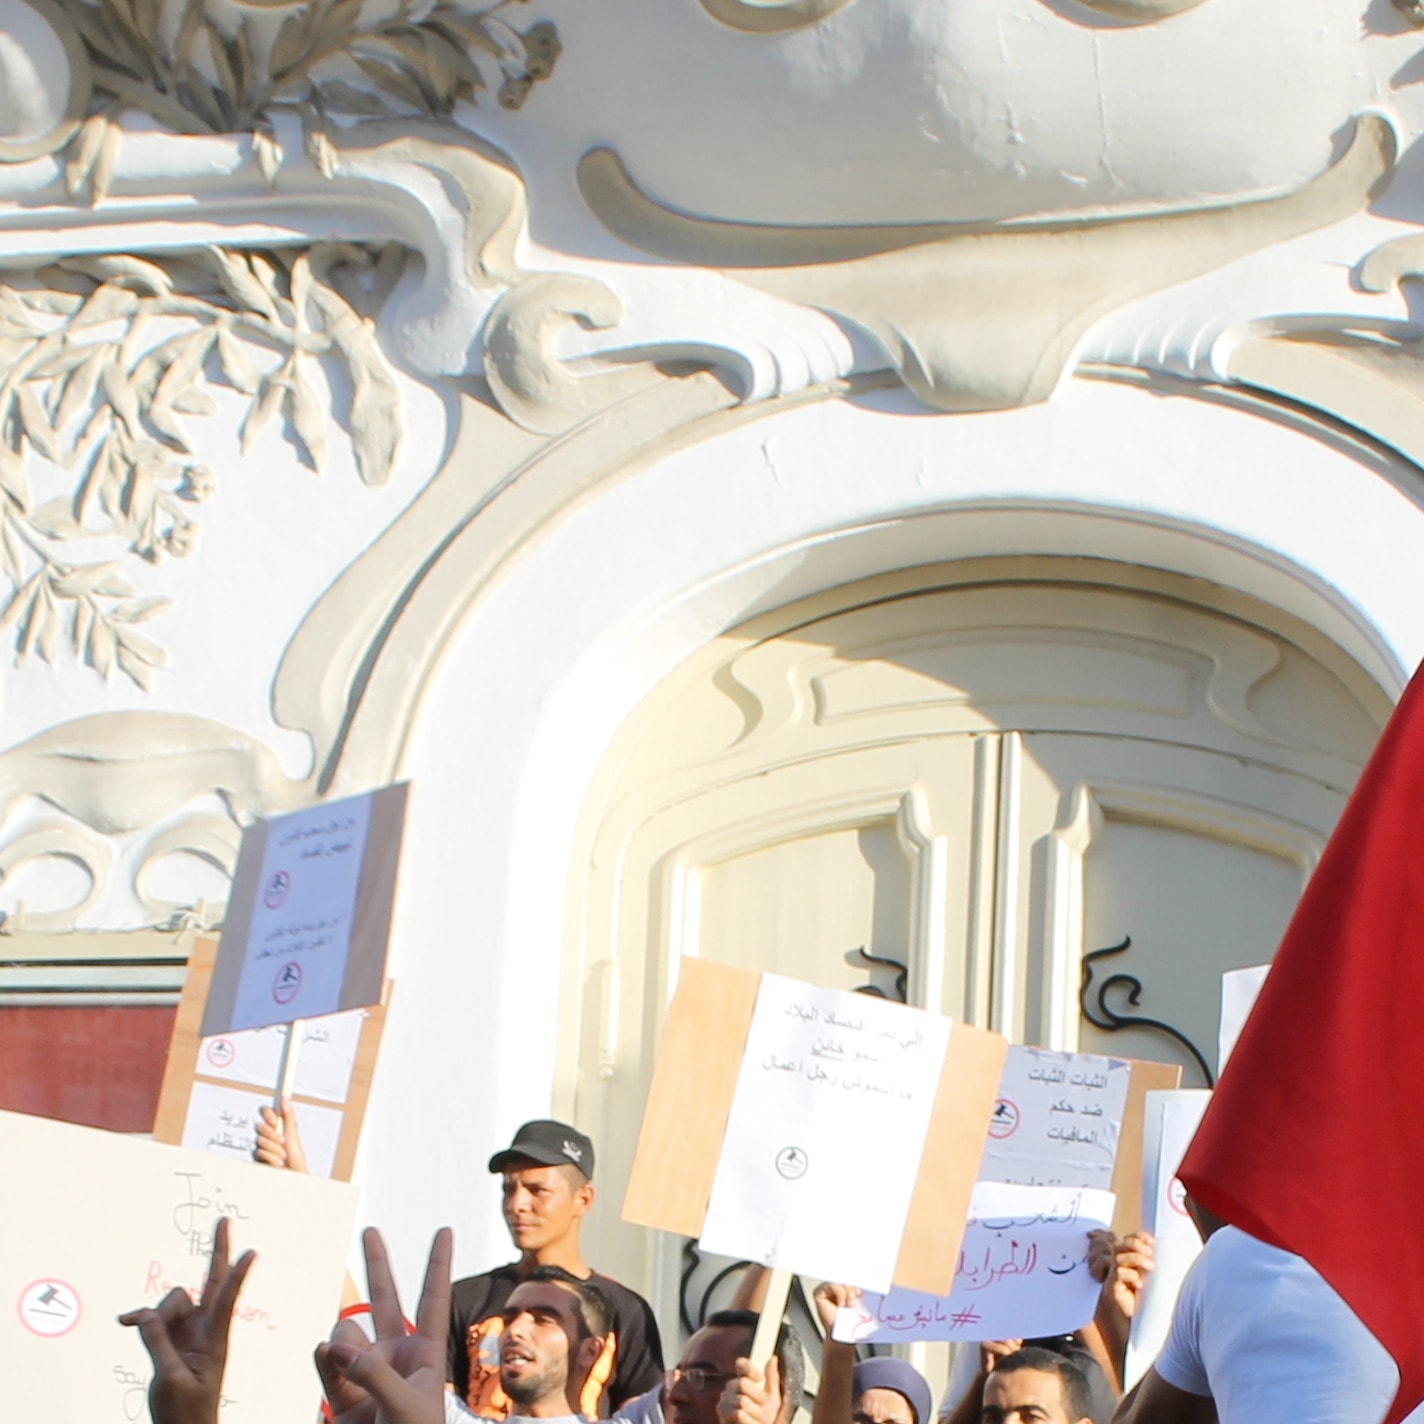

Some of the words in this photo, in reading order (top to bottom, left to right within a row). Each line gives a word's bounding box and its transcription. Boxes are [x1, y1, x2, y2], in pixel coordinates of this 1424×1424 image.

[1028, 1067, 1066, 1086] الثبات
[1070, 1072, 1108, 1091] الثبات
[1049, 1099, 1076, 1118] حكم
[1080, 1102, 1104, 1118] ضد
[1047, 1125, 1099, 1145] المافيات
[172, 1171, 252, 1236] Join
